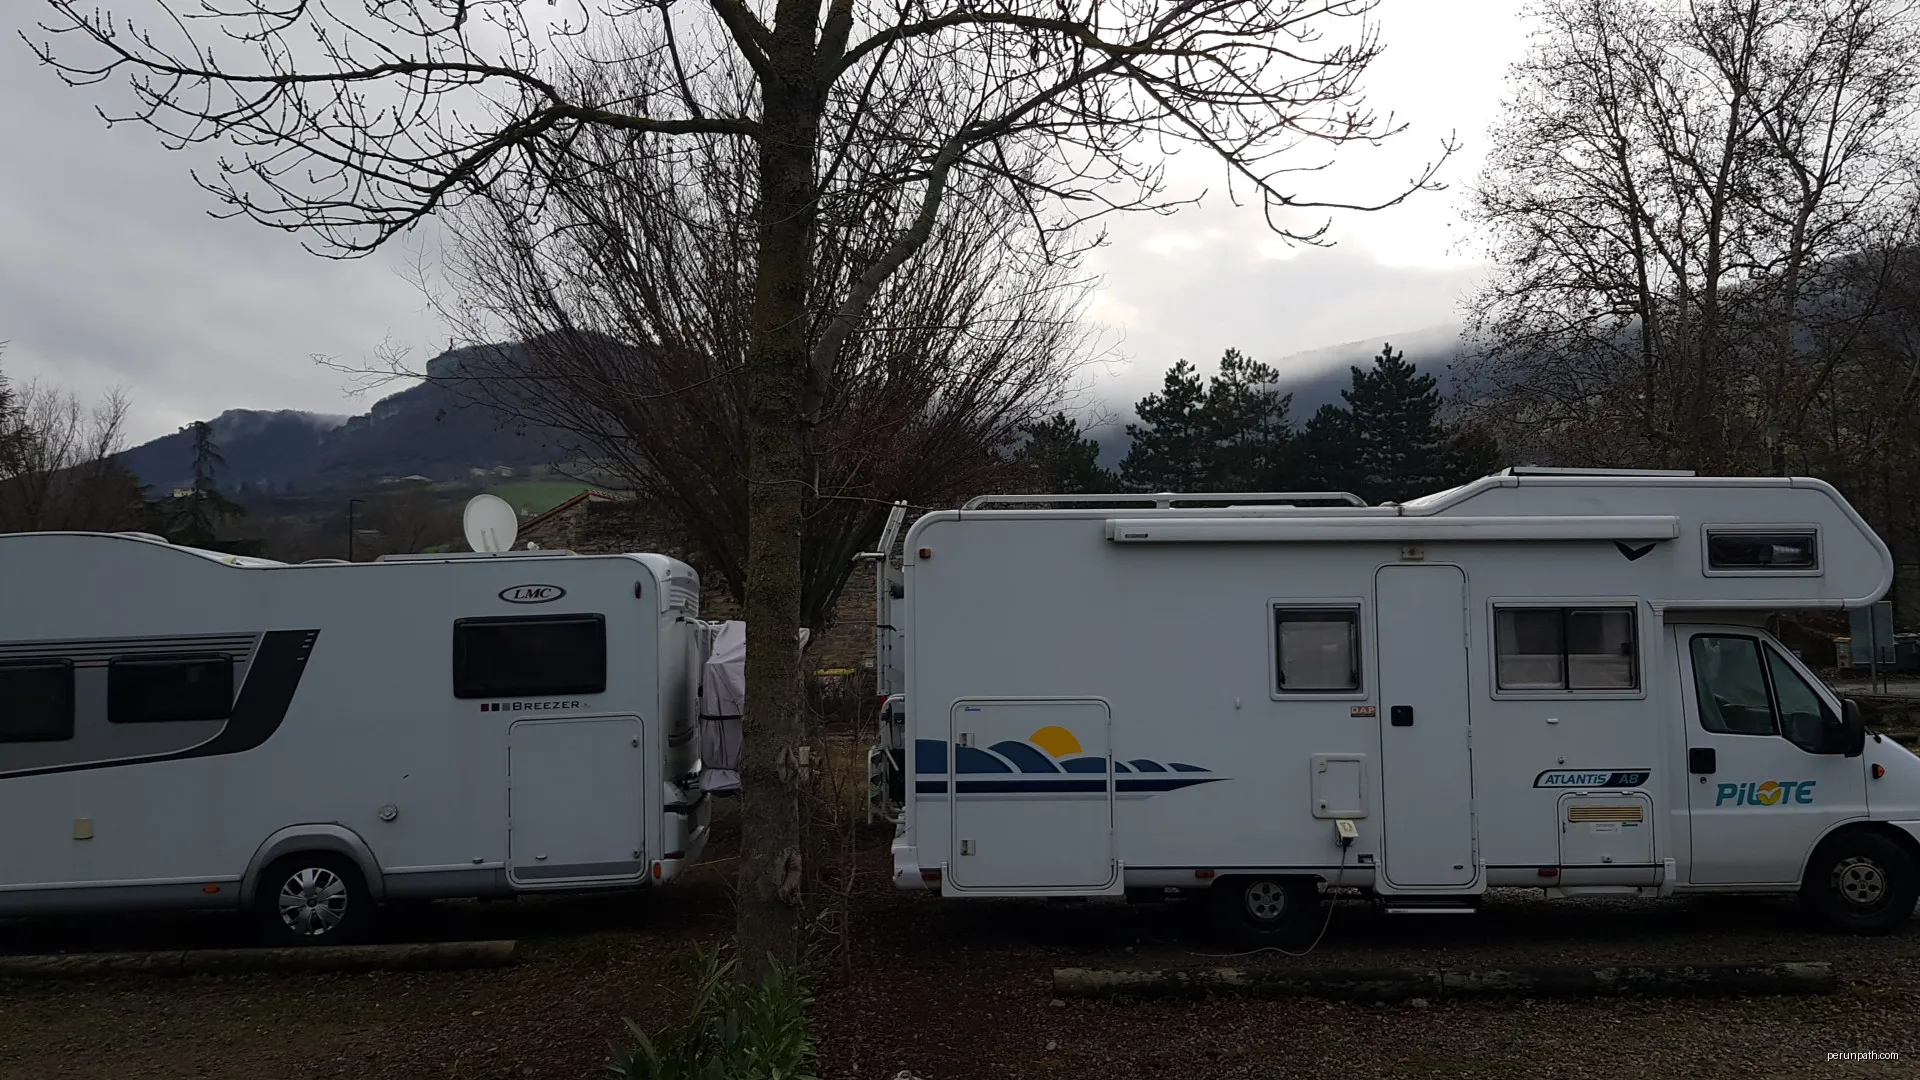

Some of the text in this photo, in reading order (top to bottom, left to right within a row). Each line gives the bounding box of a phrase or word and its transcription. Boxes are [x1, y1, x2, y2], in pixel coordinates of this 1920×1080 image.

[514, 588, 551, 600] LMC
[513, 701, 580, 711] BREEZER
[1619, 773, 1639, 784] A8
